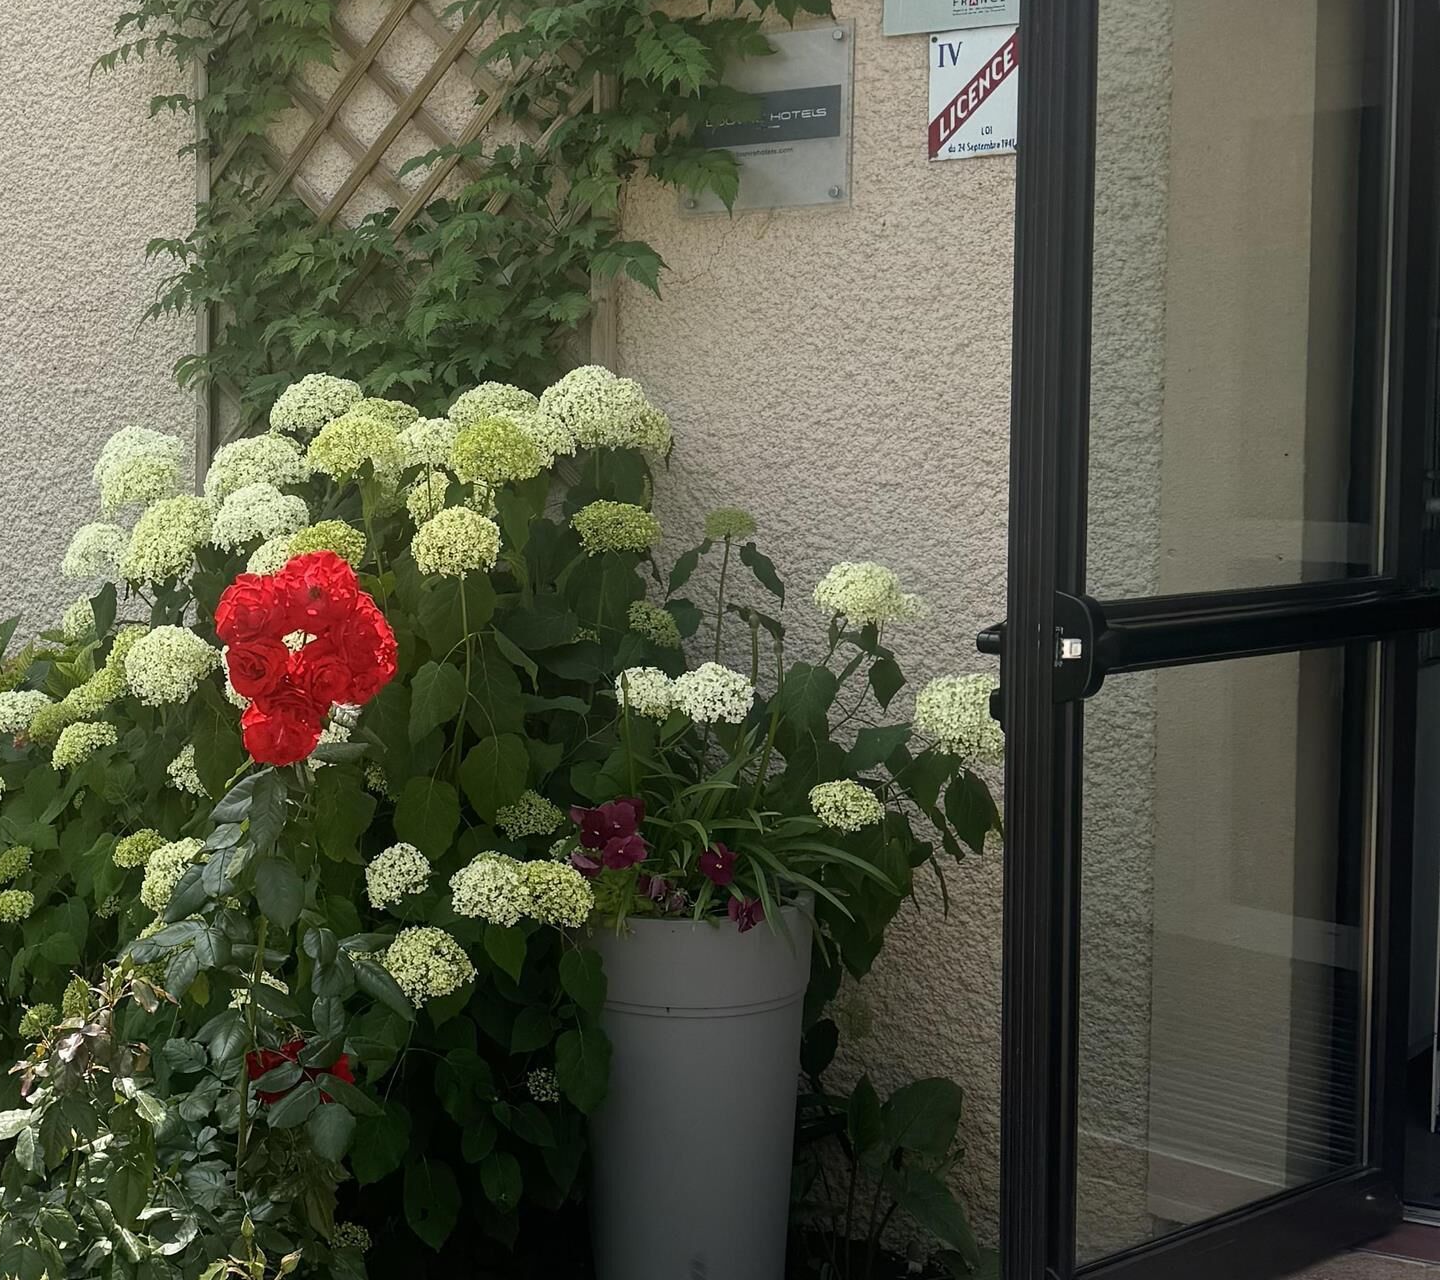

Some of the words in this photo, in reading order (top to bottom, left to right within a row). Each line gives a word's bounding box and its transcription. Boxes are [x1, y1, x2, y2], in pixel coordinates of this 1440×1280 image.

[938, 41, 963, 68] IV
[940, 42, 1014, 142] LICENCE
[769, 108, 827, 121] HOTELS
[981, 126, 993, 136] LOI
[957, 143, 966, 152] 24
[967, 140, 1001, 152] Septembre
